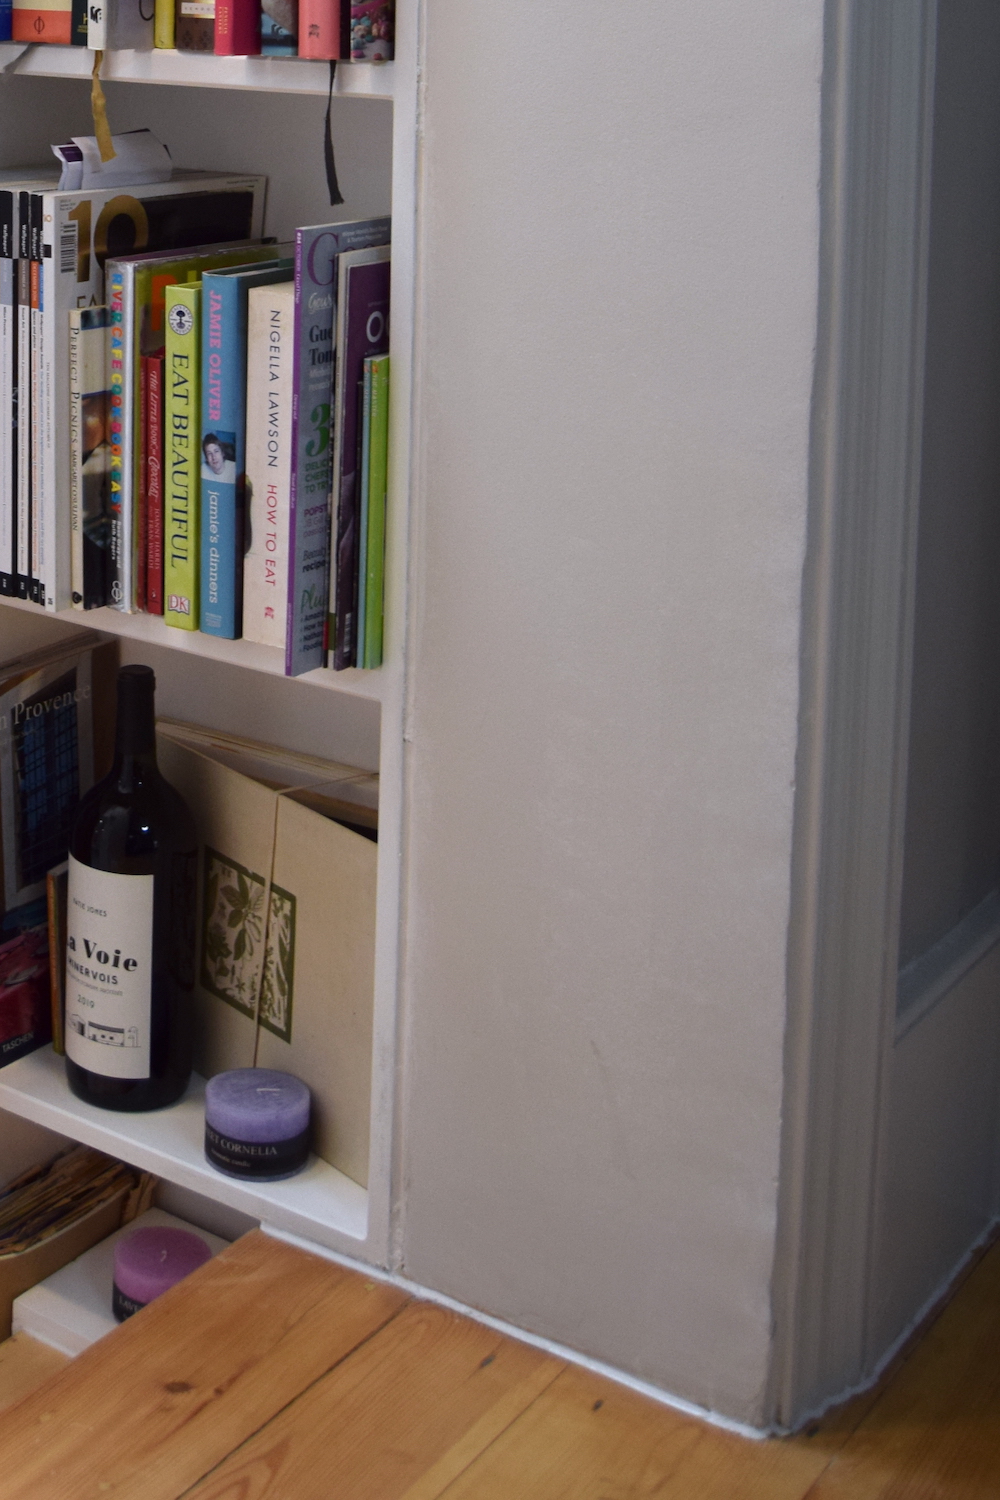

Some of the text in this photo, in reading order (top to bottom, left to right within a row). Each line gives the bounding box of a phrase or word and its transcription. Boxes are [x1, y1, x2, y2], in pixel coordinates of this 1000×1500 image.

[68, 194, 149, 283] 10
[172, 353, 189, 406] EAT
[208, 290, 222, 421] JAMIE OLIVER
[70, 327, 81, 444] PERFECT PICNICS
[110, 273, 124, 514] RIVER CAFE COOK BOOK EASY
[267, 310, 281, 468] NIGELLA LAWSON
[171, 412, 188, 569] BEAUTIFUL
[208, 490, 220, 544] jamie's
[264, 484, 278, 586] HOW TO EAT
[208, 547, 220, 603] dinners
[169, 597, 189, 613] DK
[13, 684, 92, 725] Provence
[82, 938, 138, 972] Voie
[77, 994, 95, 1009] 2019
[2, 1030, 34, 1053] TASCHEN
[221, 1139, 278, 1155] CORNELIA
